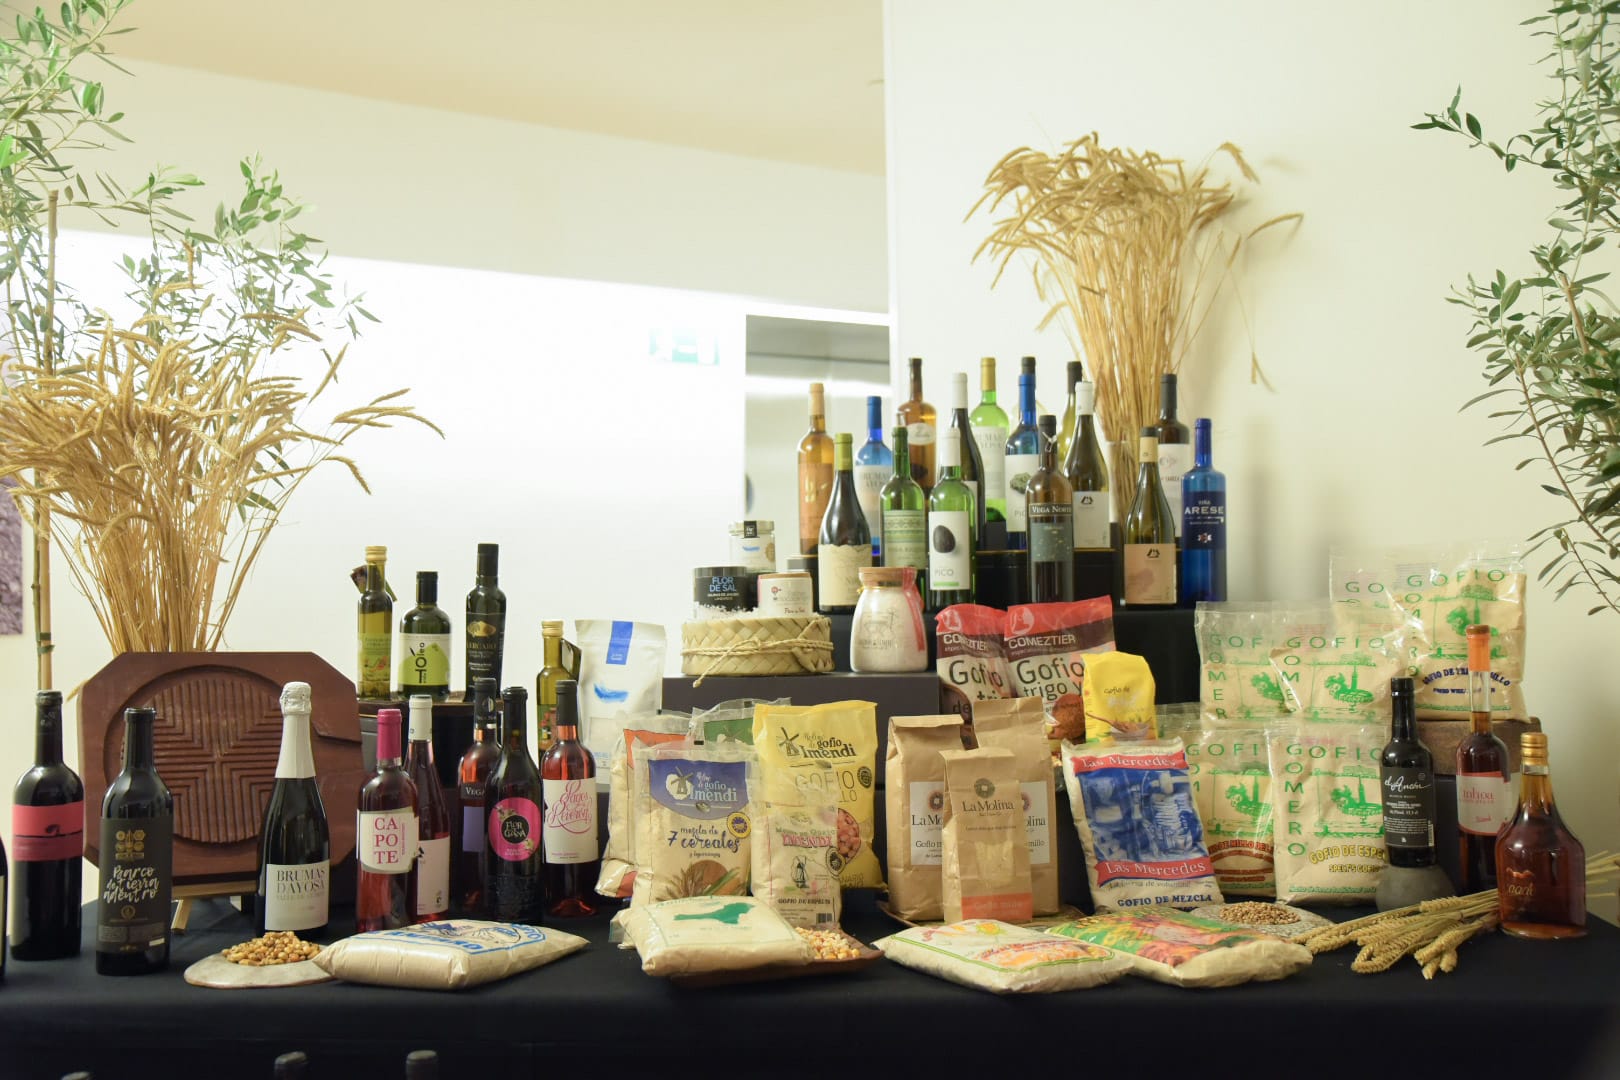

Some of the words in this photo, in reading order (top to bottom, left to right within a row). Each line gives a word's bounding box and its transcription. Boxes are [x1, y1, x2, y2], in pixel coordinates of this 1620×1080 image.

[1031, 505, 1050, 513] VEGA
[1184, 506, 1224, 515] ARESE
[711, 576, 734, 585] FLOR
[1407, 570, 1505, 588] GOFIO
[709, 585, 721, 593] DE
[723, 585, 737, 593] SAL
[1008, 634, 1076, 649] COMEZTIER
[1286, 636, 1385, 649] GOFIO
[949, 660, 1004, 687] Gofio
[1016, 657, 1085, 685] Gofio
[1024, 681, 1068, 701] trigo
[816, 736, 842, 750] gofio
[799, 743, 857, 759] Imendi
[1082, 758, 1105, 769] Las
[1109, 755, 1177, 768] Mercedes
[704, 780, 727, 791] gofio
[689, 787, 738, 802] Imendi
[962, 801, 977, 812] La
[977, 800, 1015, 812] Molina
[374, 817, 399, 831] CA
[911, 815, 927, 826] La
[374, 834, 399, 847] PO
[667, 830, 679, 847] 7
[681, 831, 740, 853] cereales
[915, 840, 936, 849] Gofio
[373, 850, 399, 865] TE
[1308, 844, 1335, 864] GOFIO
[1335, 843, 1348, 853] DE
[277, 868, 326, 882] BRUMAS
[1105, 862, 1130, 875] Las
[1134, 861, 1206, 876] Mercedes
[1117, 896, 1151, 908] GOFIO
[1155, 895, 1169, 904] DE
[1172, 893, 1213, 903] MEZCLA
